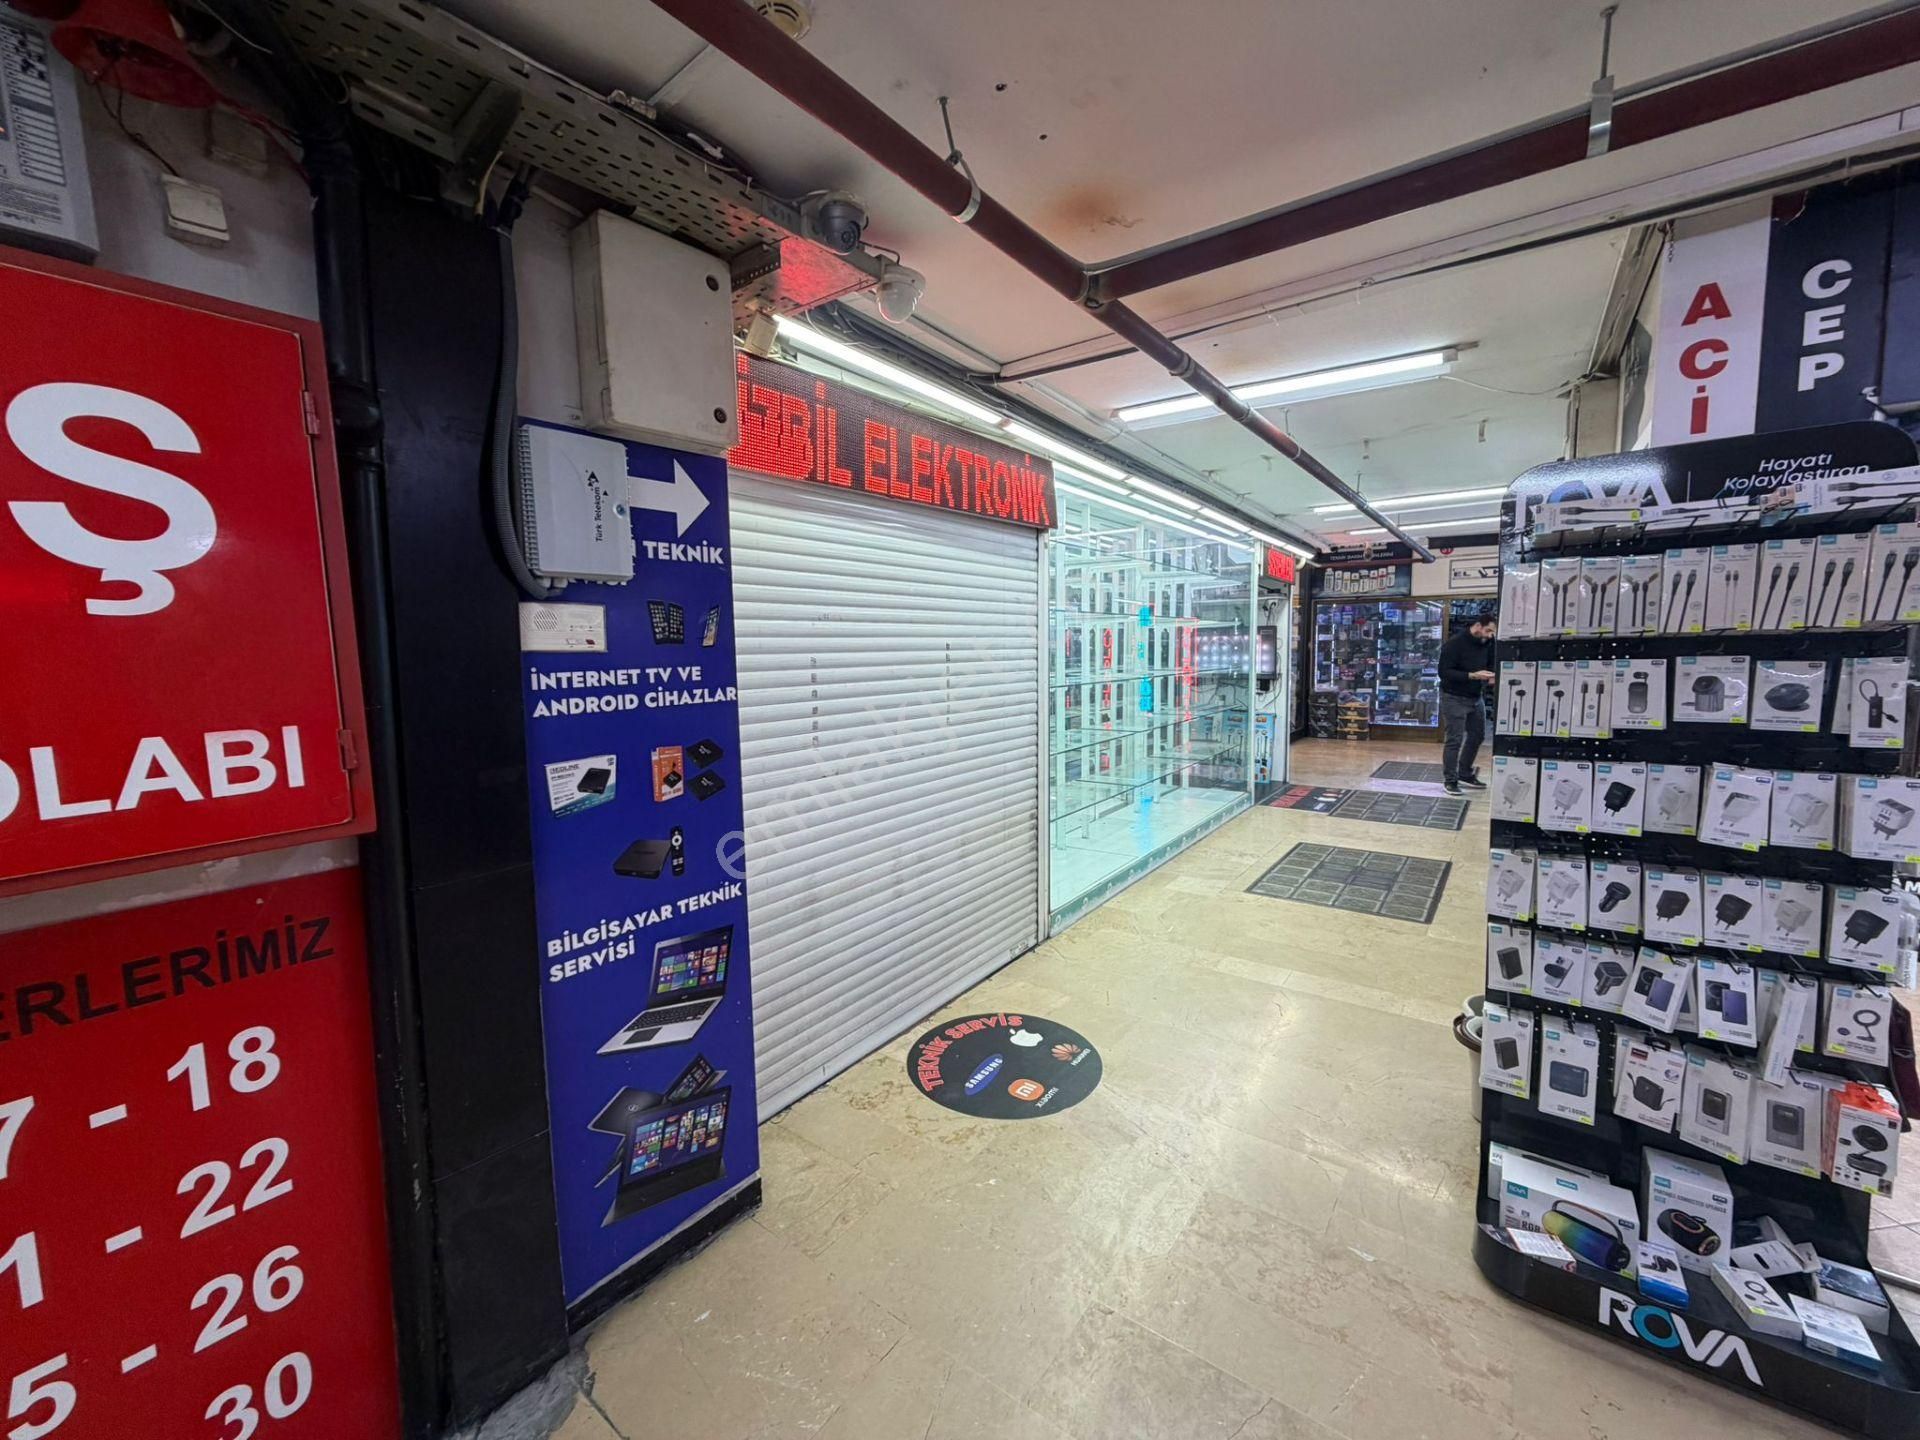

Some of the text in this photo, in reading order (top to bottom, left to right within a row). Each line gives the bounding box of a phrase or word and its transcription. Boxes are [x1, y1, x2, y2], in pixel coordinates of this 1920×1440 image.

[1678, 281, 1732, 435] ACİ
[1798, 259, 1852, 391] CEP
[5, 381, 218, 617] Ş
[863, 418, 1050, 526] ELEKTRONİK
[1758, 453, 1833, 474] Hayatı
[593, 486, 604, 543] Türk Telekom
[642, 539, 725, 565] TEKNİK
[531, 665, 702, 691] İNTERNET TV VE
[532, 686, 737, 718] ANDROID CİHAZLAR
[0, 724, 305, 823] LABI
[546, 881, 743, 958] BİLGİSAYAR TEKNİK
[549, 934, 636, 983] SERVİSİ
[0, 913, 336, 1042] RLERİMİZ
[166, 1025, 282, 1112] 18
[917, 1012, 1024, 1093] TEKNİK SERVİS
[964, 1057, 1004, 1089] SAMSUNG
[175, 1136, 294, 1240] 22
[6, 1352, 78, 1440] 5
[189, 1244, 305, 1354] 26
[1597, 1286, 1765, 1388] ROVA
[203, 1351, 314, 1440] 30
